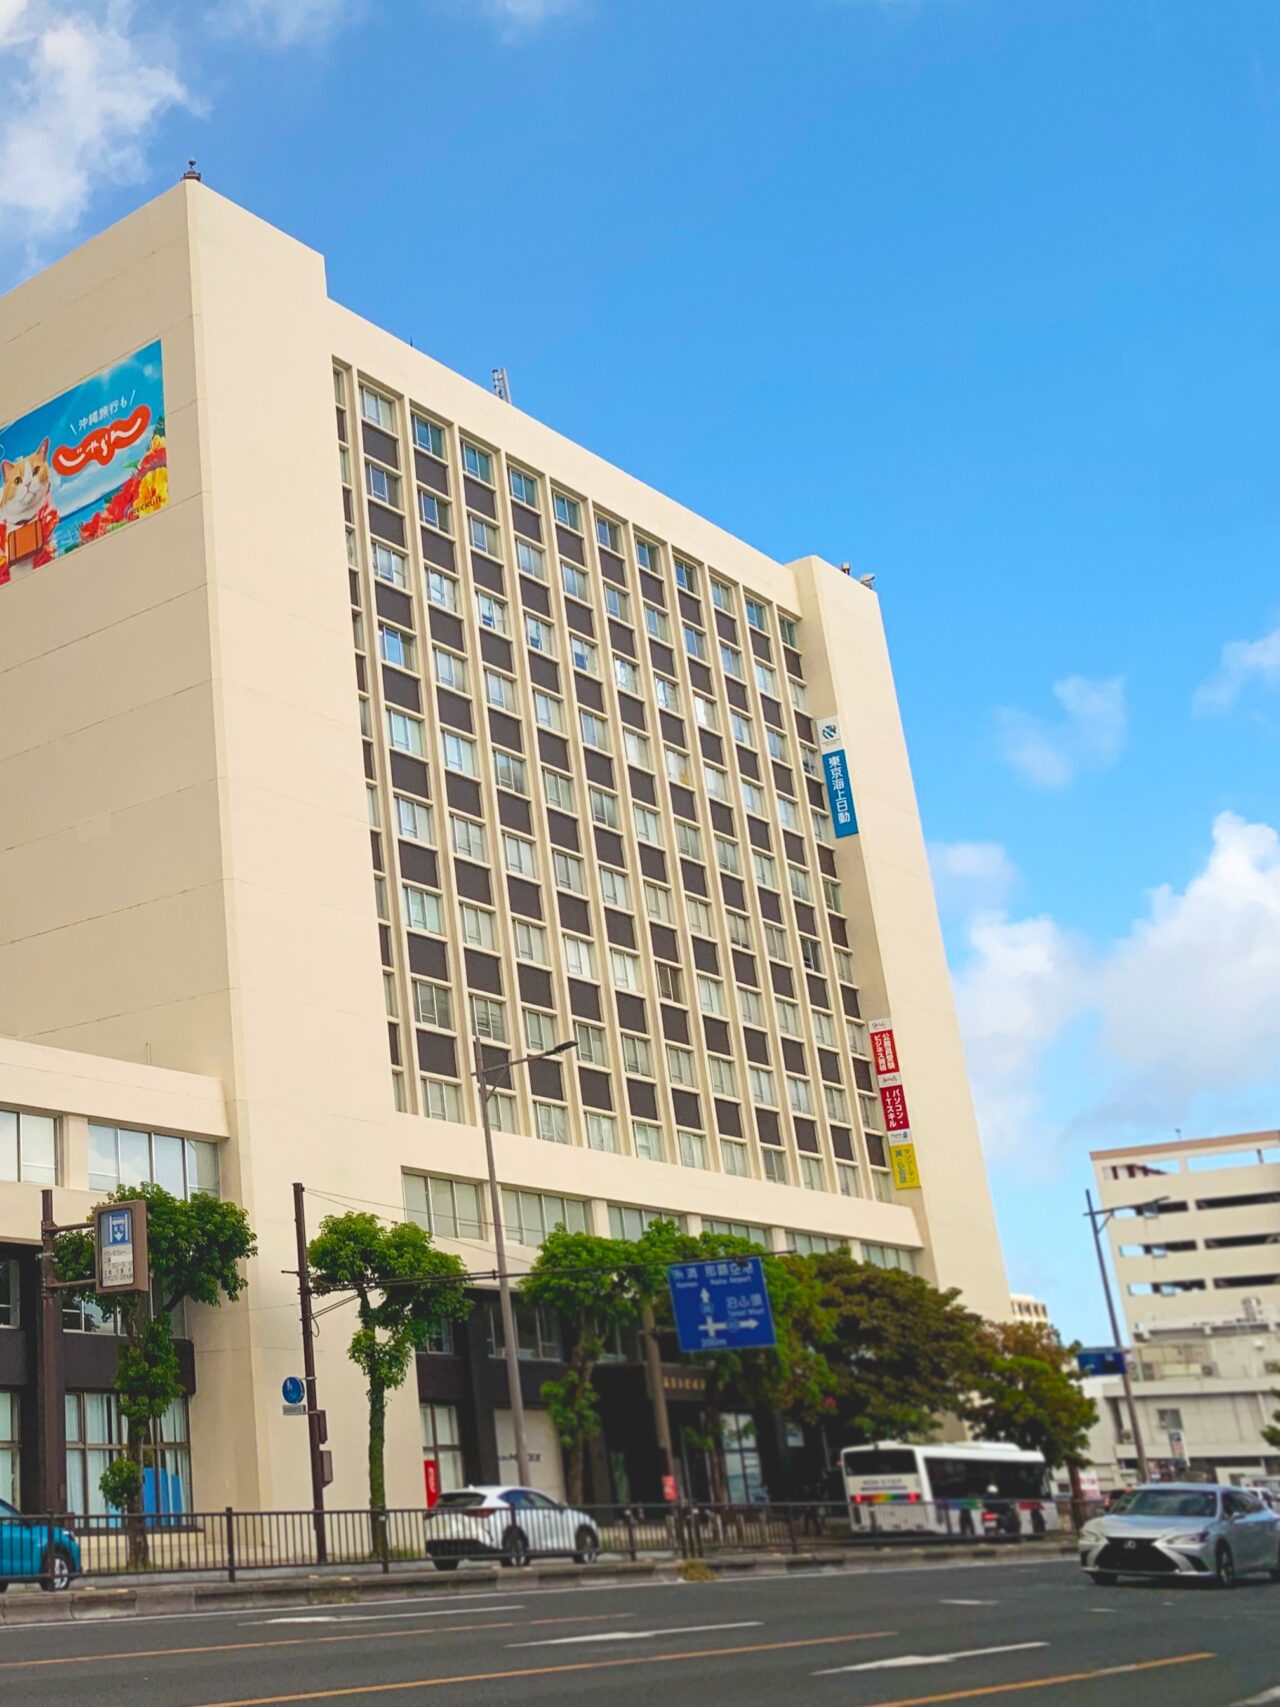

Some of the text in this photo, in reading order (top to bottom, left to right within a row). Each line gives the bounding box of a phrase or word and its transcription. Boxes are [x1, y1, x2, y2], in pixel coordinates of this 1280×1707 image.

[78, 396, 128, 431] 沖縄旅行も
[58, 417, 142, 466] じゃらん
[828, 755, 851, 824] 東京海上日動
